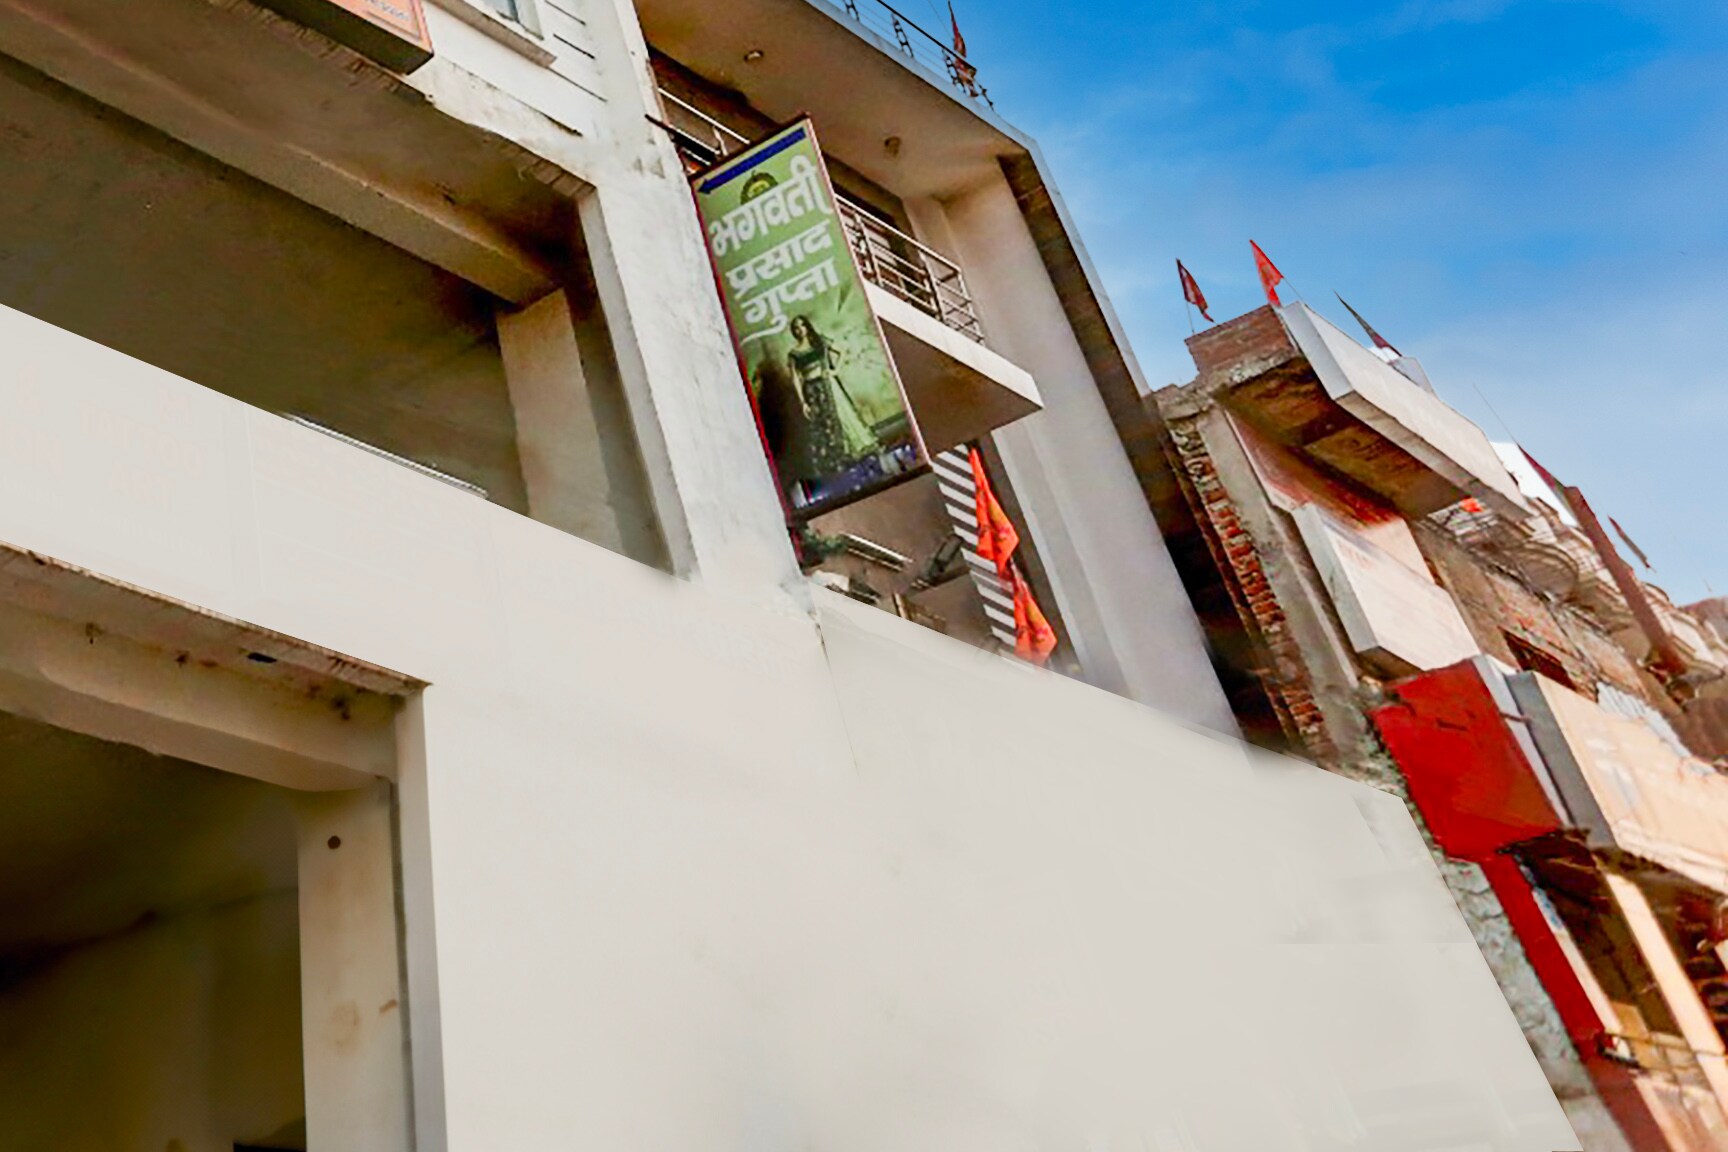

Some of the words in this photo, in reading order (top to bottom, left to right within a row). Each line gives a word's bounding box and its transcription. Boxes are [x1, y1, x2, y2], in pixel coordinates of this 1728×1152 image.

[710, 155, 833, 256] भगवती
[726, 219, 834, 299] प्रसाद
[739, 259, 838, 346] गुप्ता
